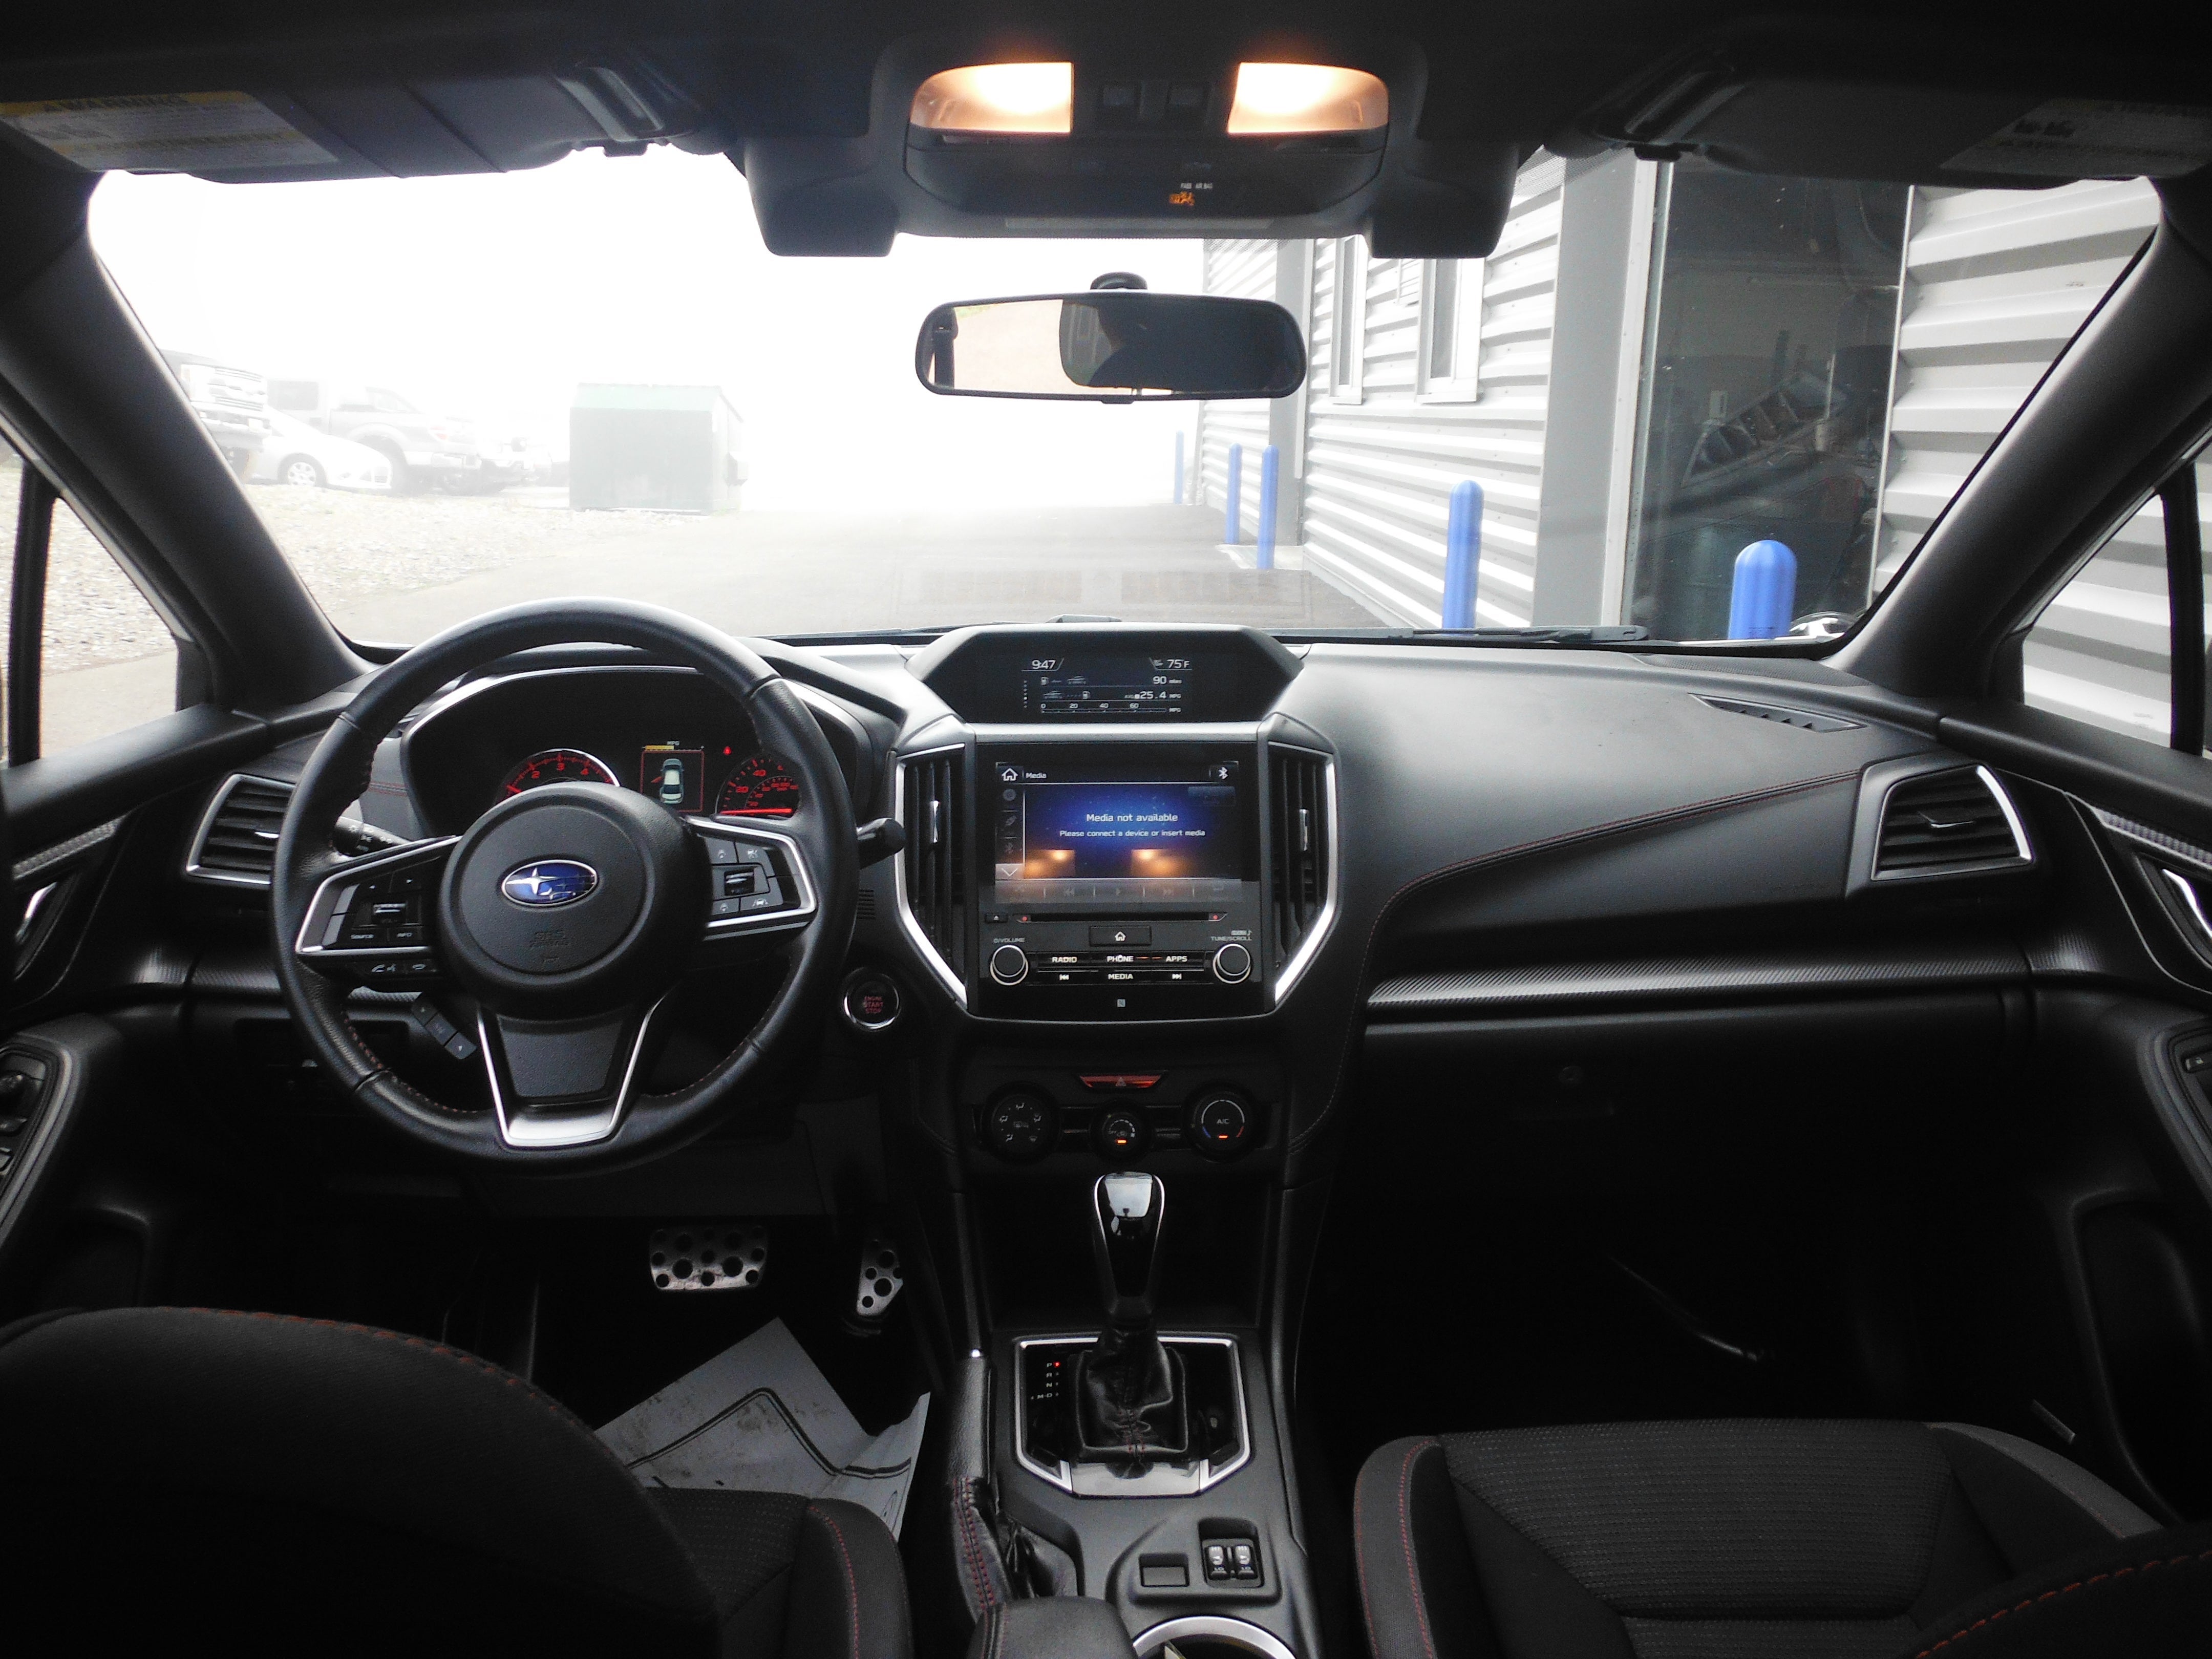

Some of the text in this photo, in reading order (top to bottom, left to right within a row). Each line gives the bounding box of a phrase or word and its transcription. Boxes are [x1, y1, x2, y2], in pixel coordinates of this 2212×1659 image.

[1153, 676, 1167, 685] 90
[1140, 691, 1167, 699] 25.4
[556, 762, 565, 772] 3
[531, 771, 540, 779] 2
[1086, 814, 1114, 822] Media
[1136, 814, 1178, 822] available
